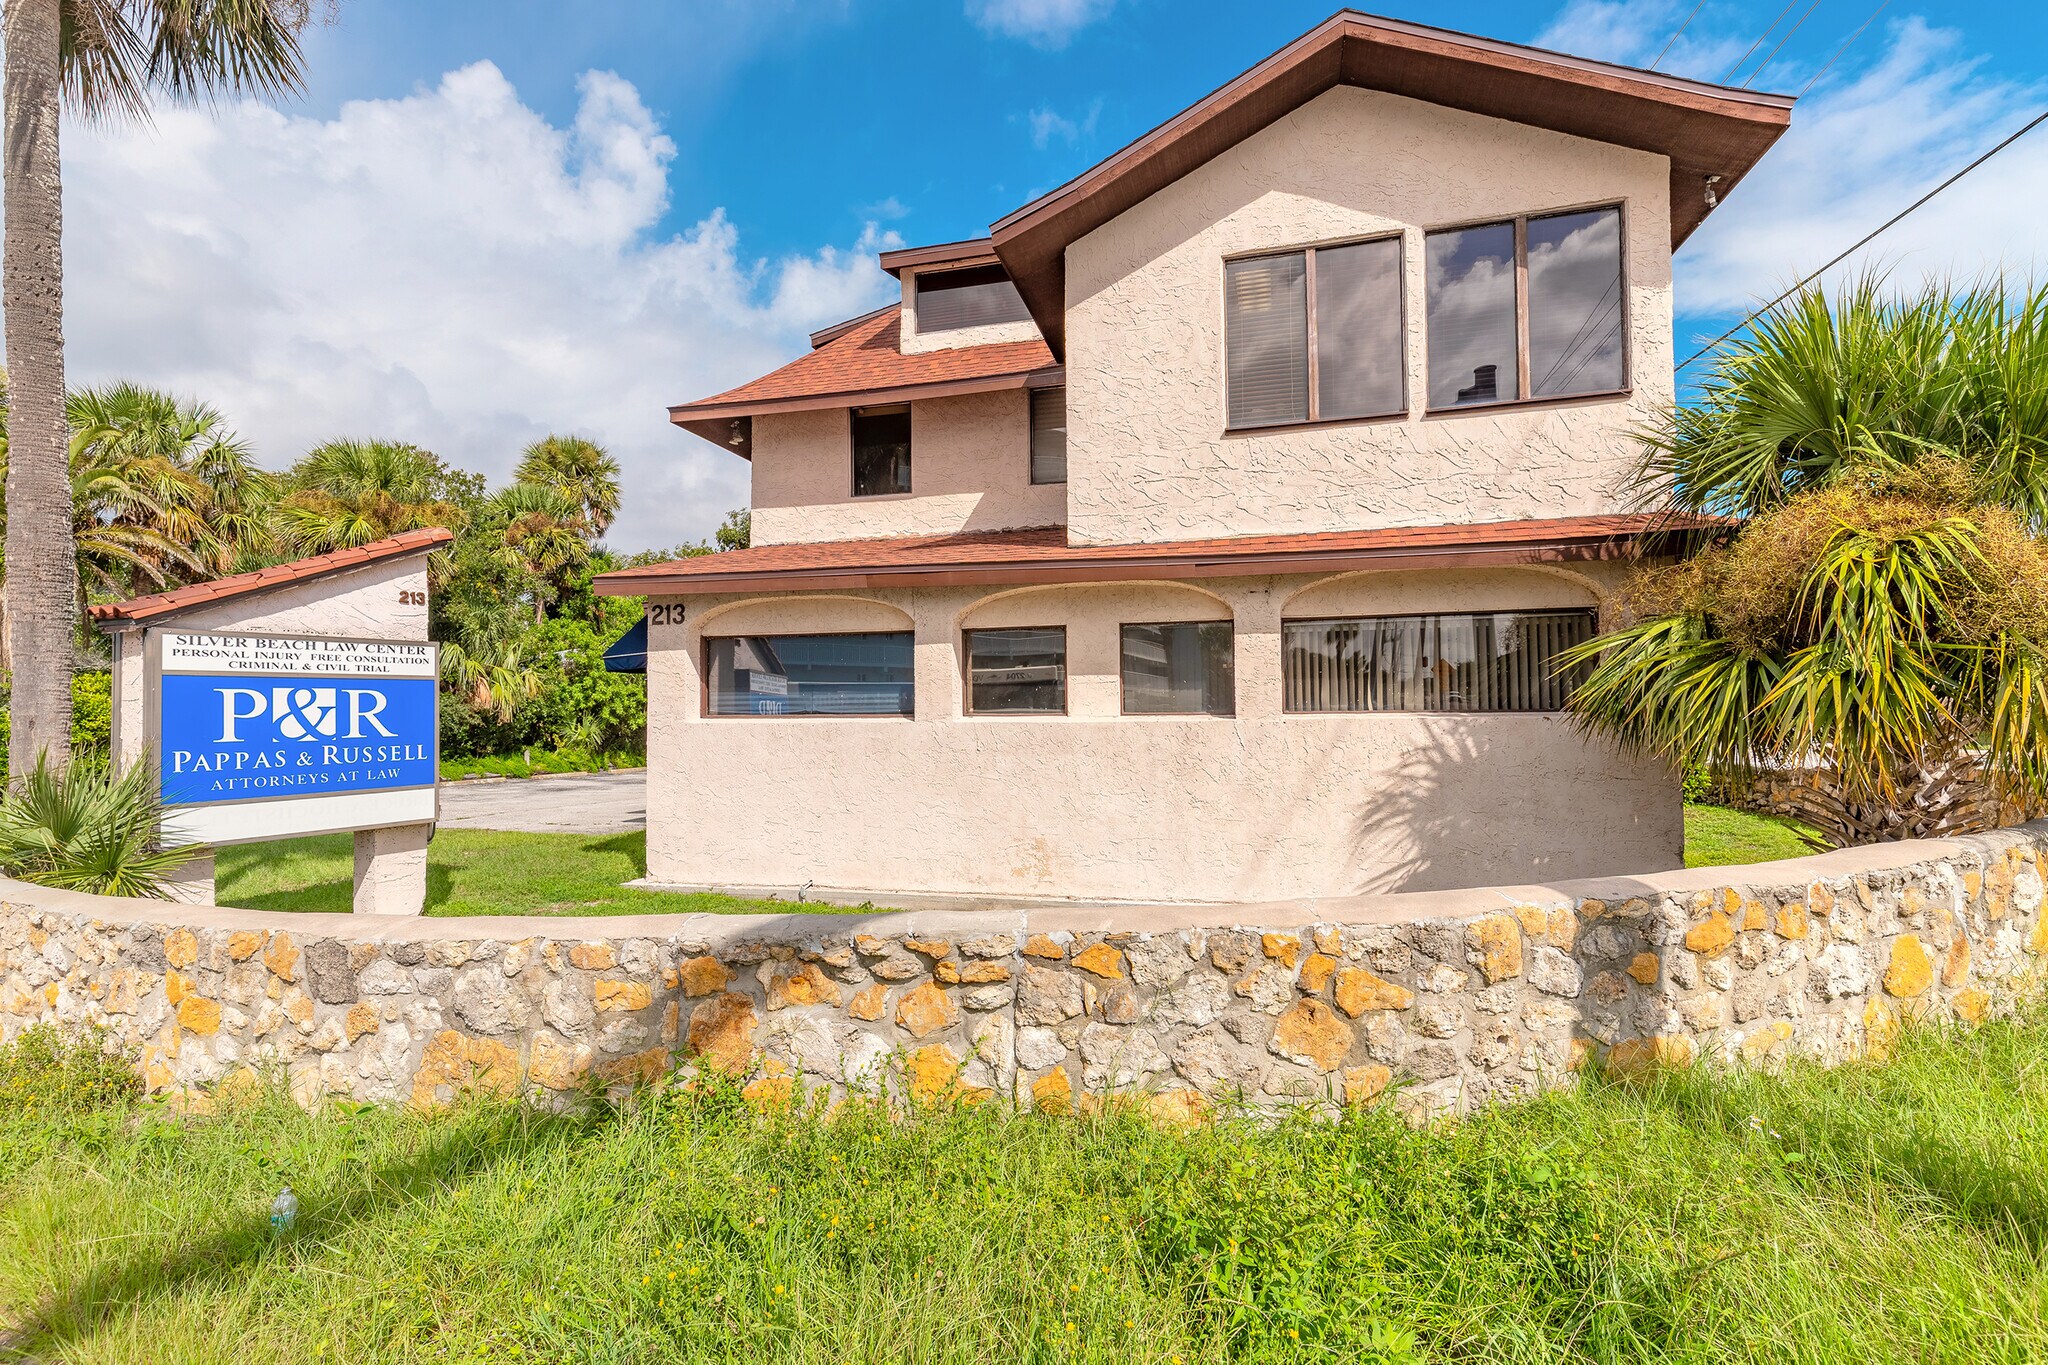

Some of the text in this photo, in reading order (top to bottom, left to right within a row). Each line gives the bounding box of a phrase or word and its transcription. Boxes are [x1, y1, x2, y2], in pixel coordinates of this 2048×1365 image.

[399, 590, 425, 606] 213
[651, 603, 685, 625] 213
[176, 634, 426, 655] SILVER BEACH LAW CENTER
[172, 648, 430, 665] PERSONAL INJURY FREE CONSULTATION
[228, 661, 390, 673] CRIMINAL & CIVIL TRIAL
[172, 744, 428, 774] PAPPAS & RUSSELL
[210, 768, 401, 791] ATTORNEYS AT LAW
